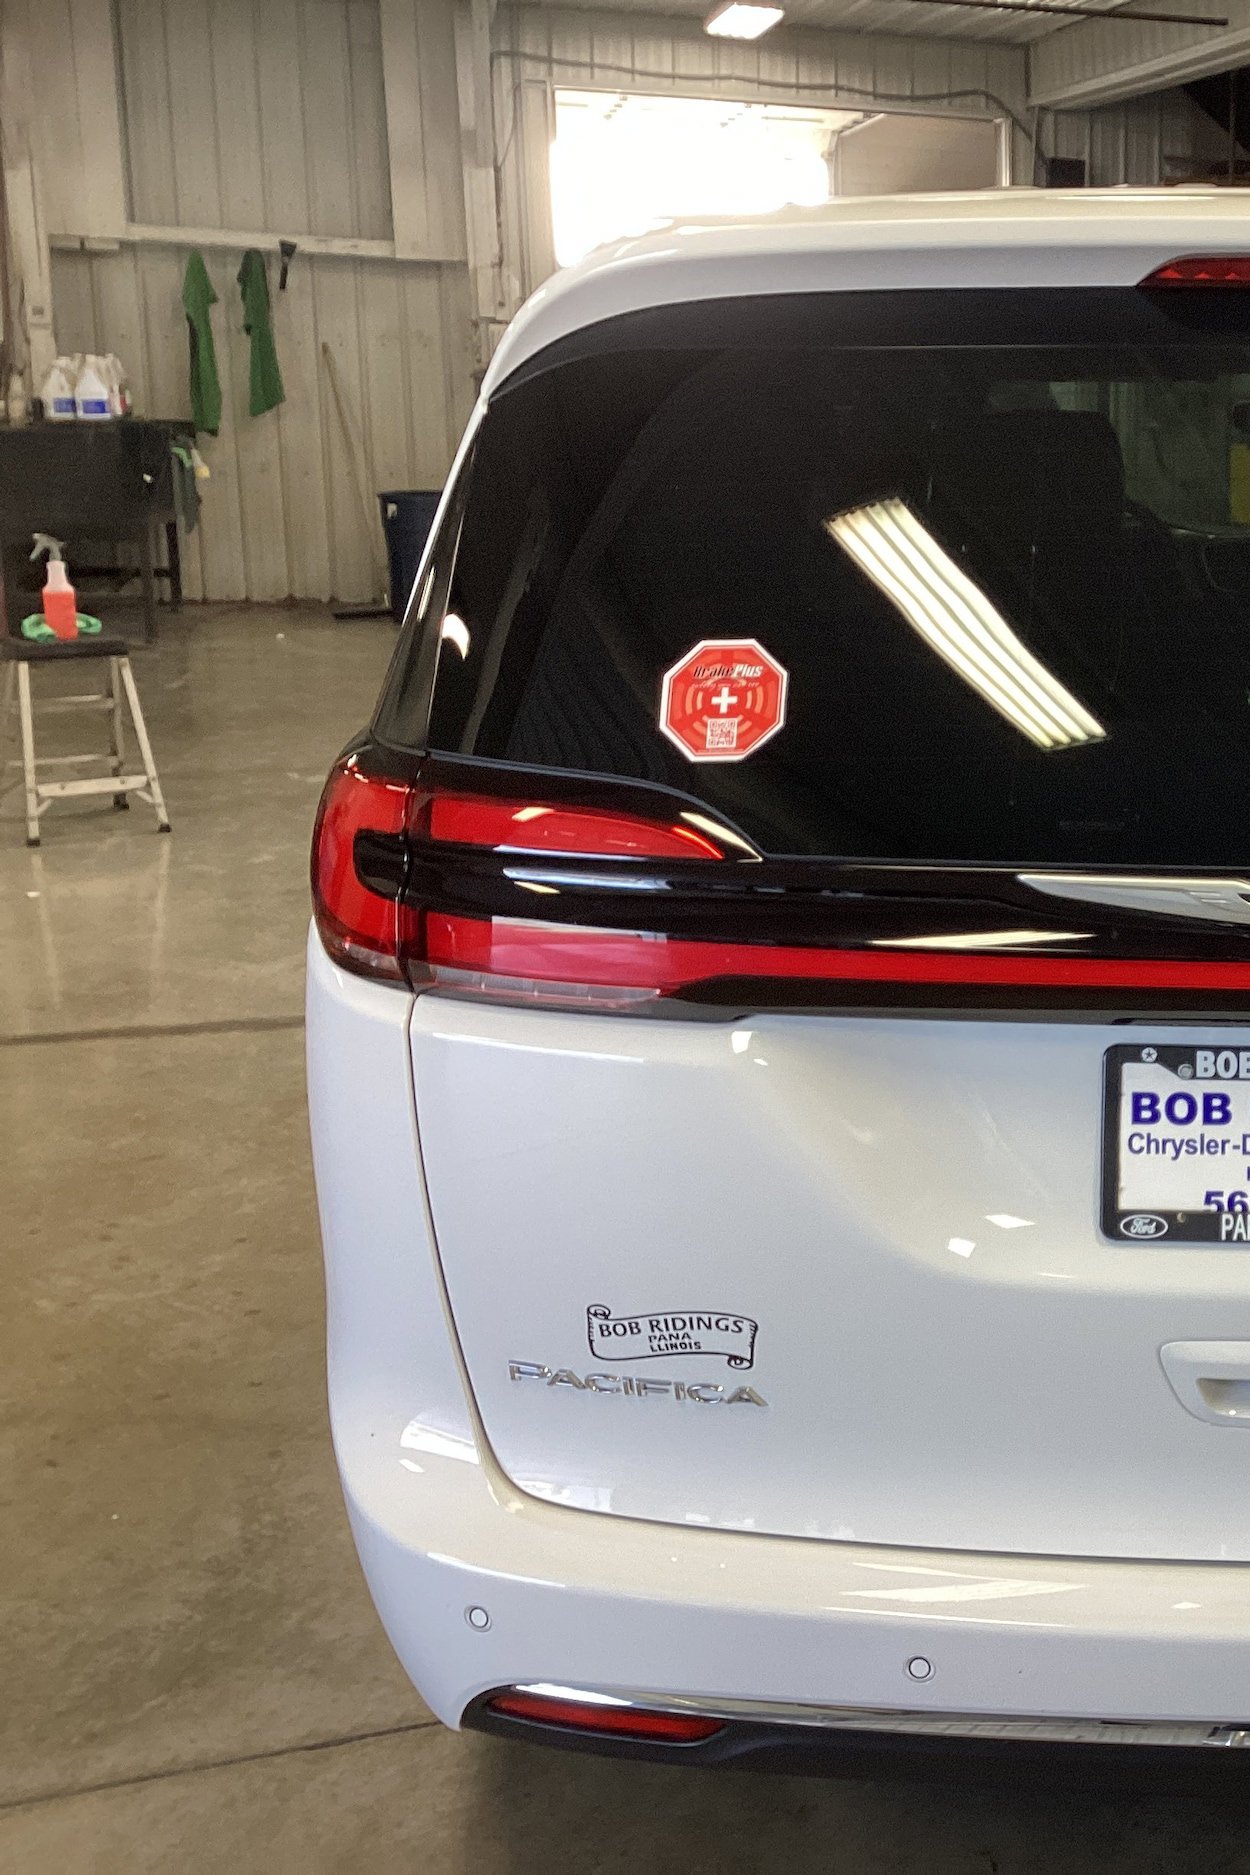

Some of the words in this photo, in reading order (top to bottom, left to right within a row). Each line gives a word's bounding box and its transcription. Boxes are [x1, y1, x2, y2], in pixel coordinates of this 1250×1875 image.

[1131, 1091, 1233, 1126] BOB
[1130, 1217, 1157, 1234] Ford
[599, 1321, 642, 1337] BOB
[648, 1316, 744, 1333] RIDINGS
[647, 1332, 692, 1343] PANA
[508, 1359, 769, 1407] PACIFICA
